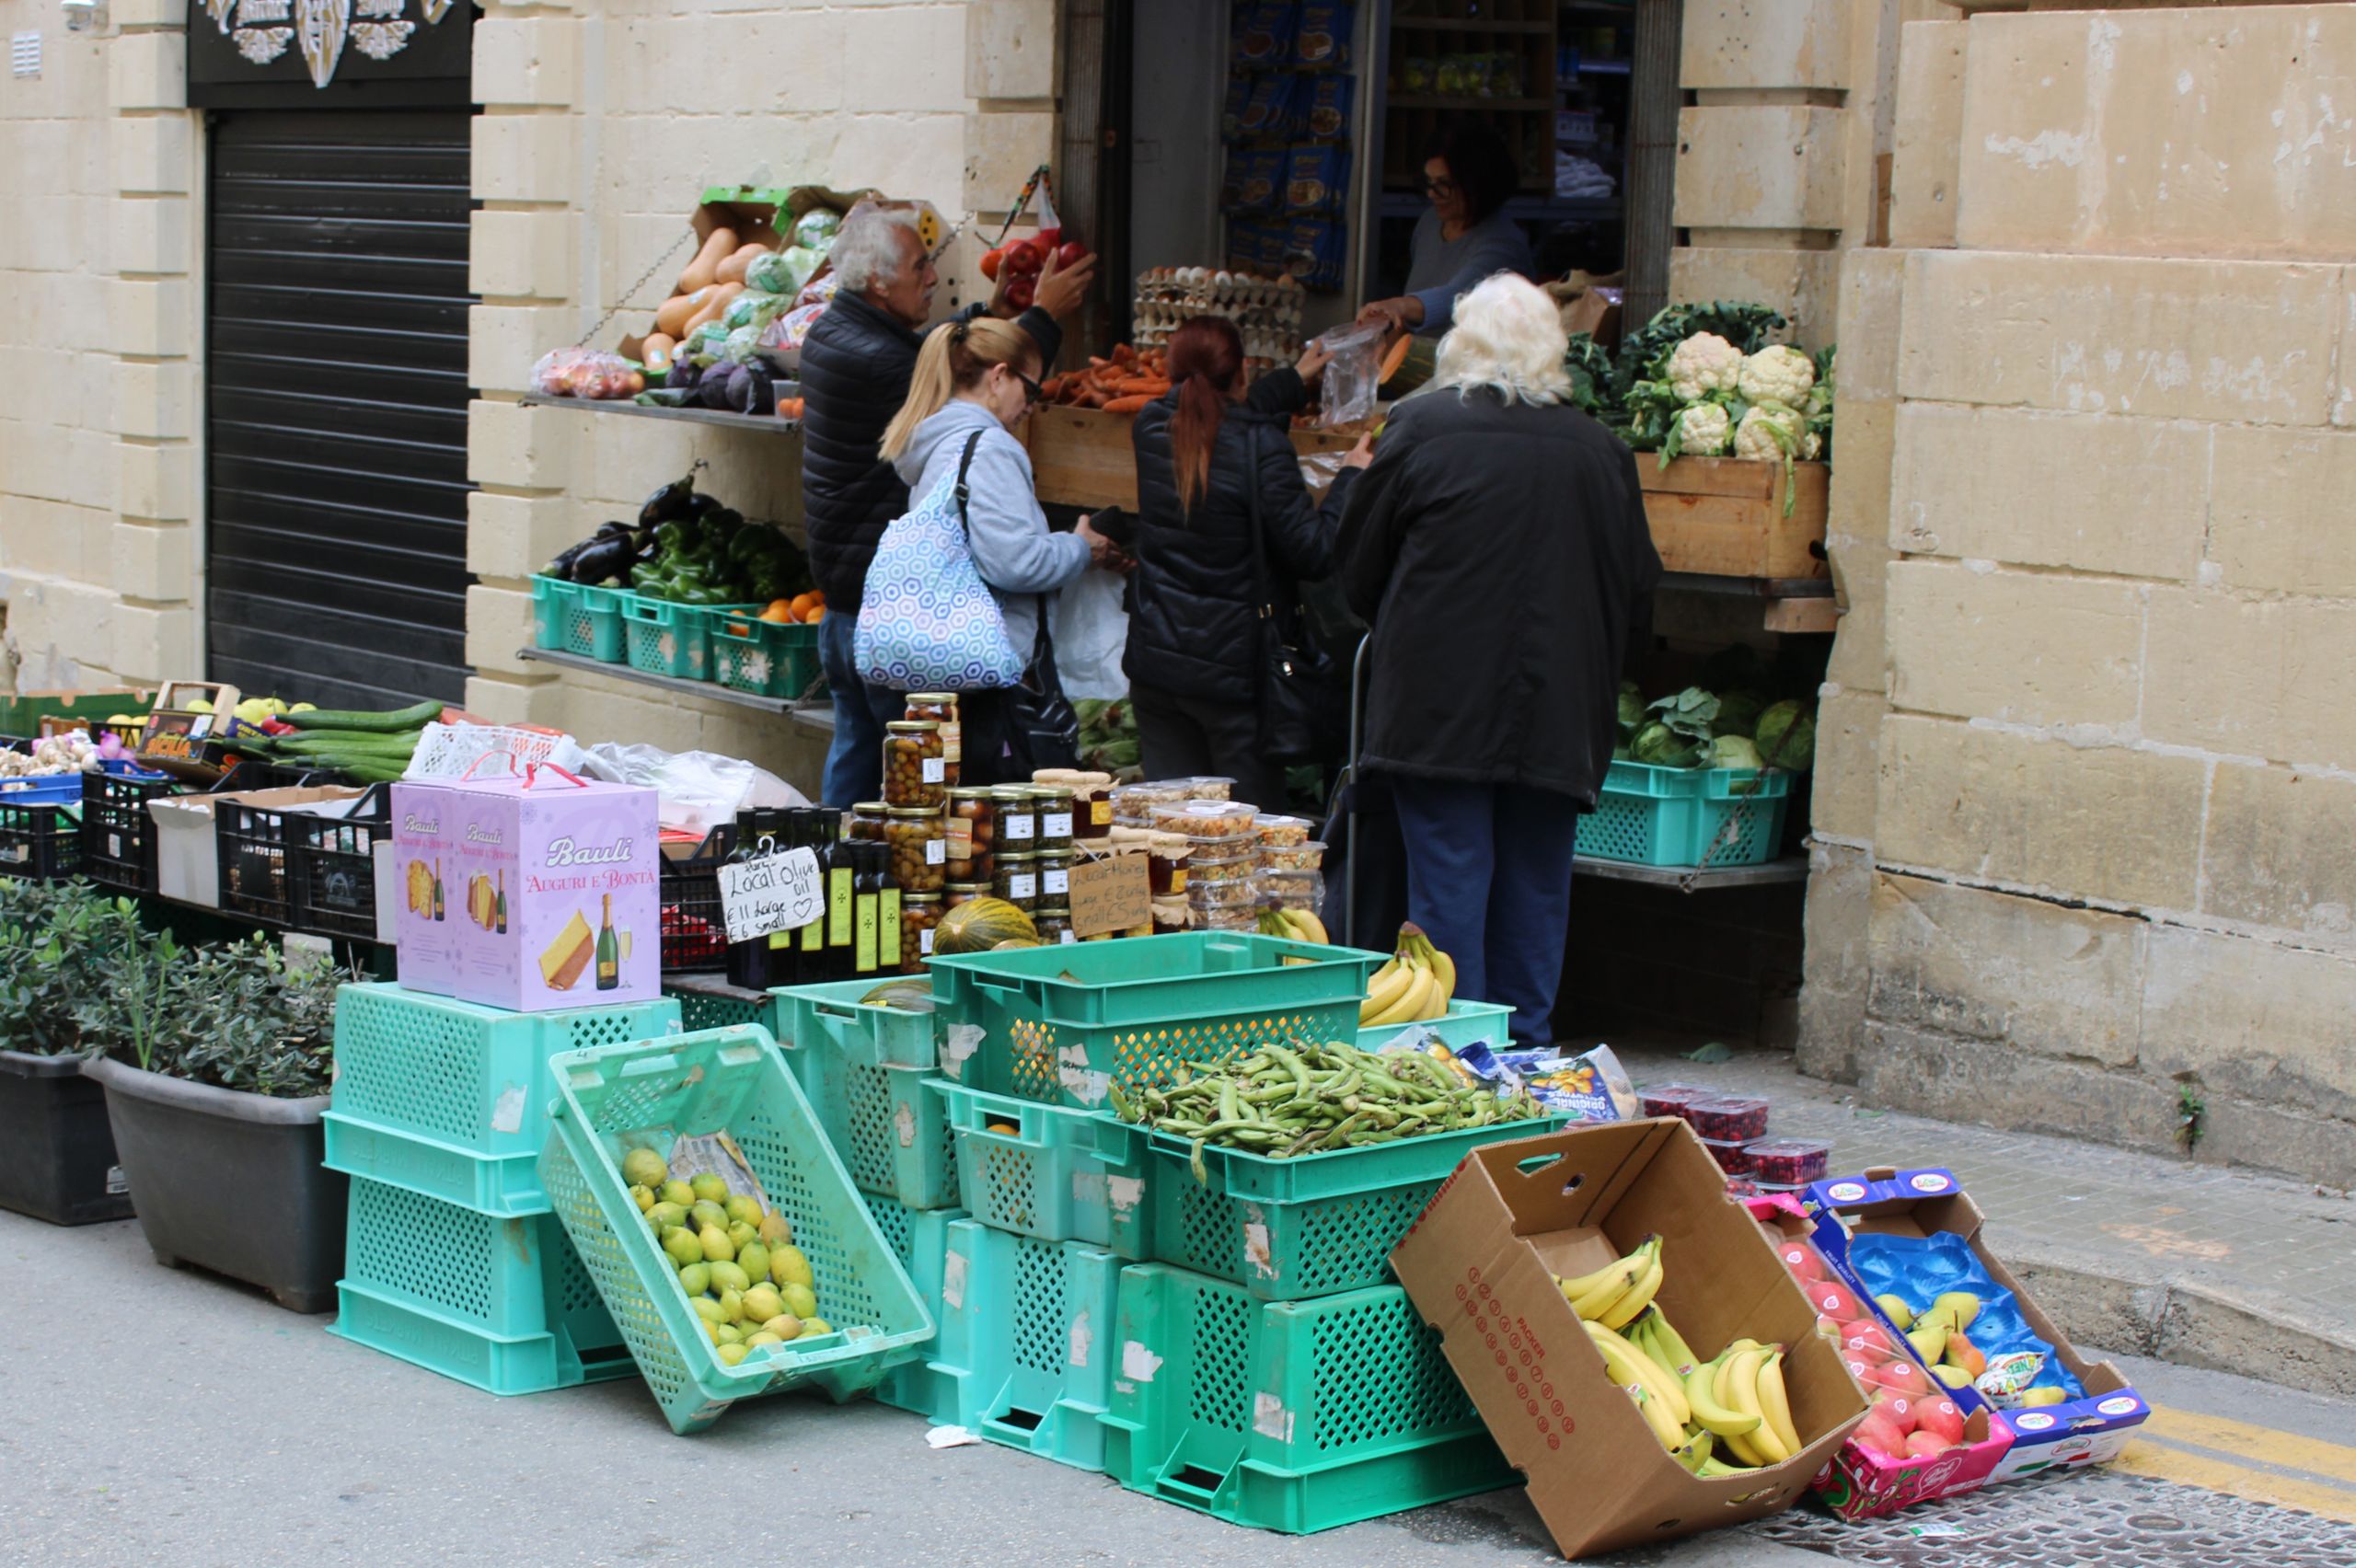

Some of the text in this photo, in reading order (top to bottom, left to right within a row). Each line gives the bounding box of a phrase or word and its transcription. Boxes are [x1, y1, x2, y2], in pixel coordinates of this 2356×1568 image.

[145, 738, 191, 758] SICILIA
[405, 814, 439, 834] Bauli
[468, 824, 502, 844] Bauli
[545, 835, 634, 868] Bauli
[526, 869, 655, 894] AUGURI E BONTÀ
[731, 859, 814, 898] Local Olive
[1553, 1096, 1606, 1111] ORIGINAL
[1825, 1249, 1856, 1285] FRUIT QUALITY
[1517, 1316, 1546, 1360] PACKER
